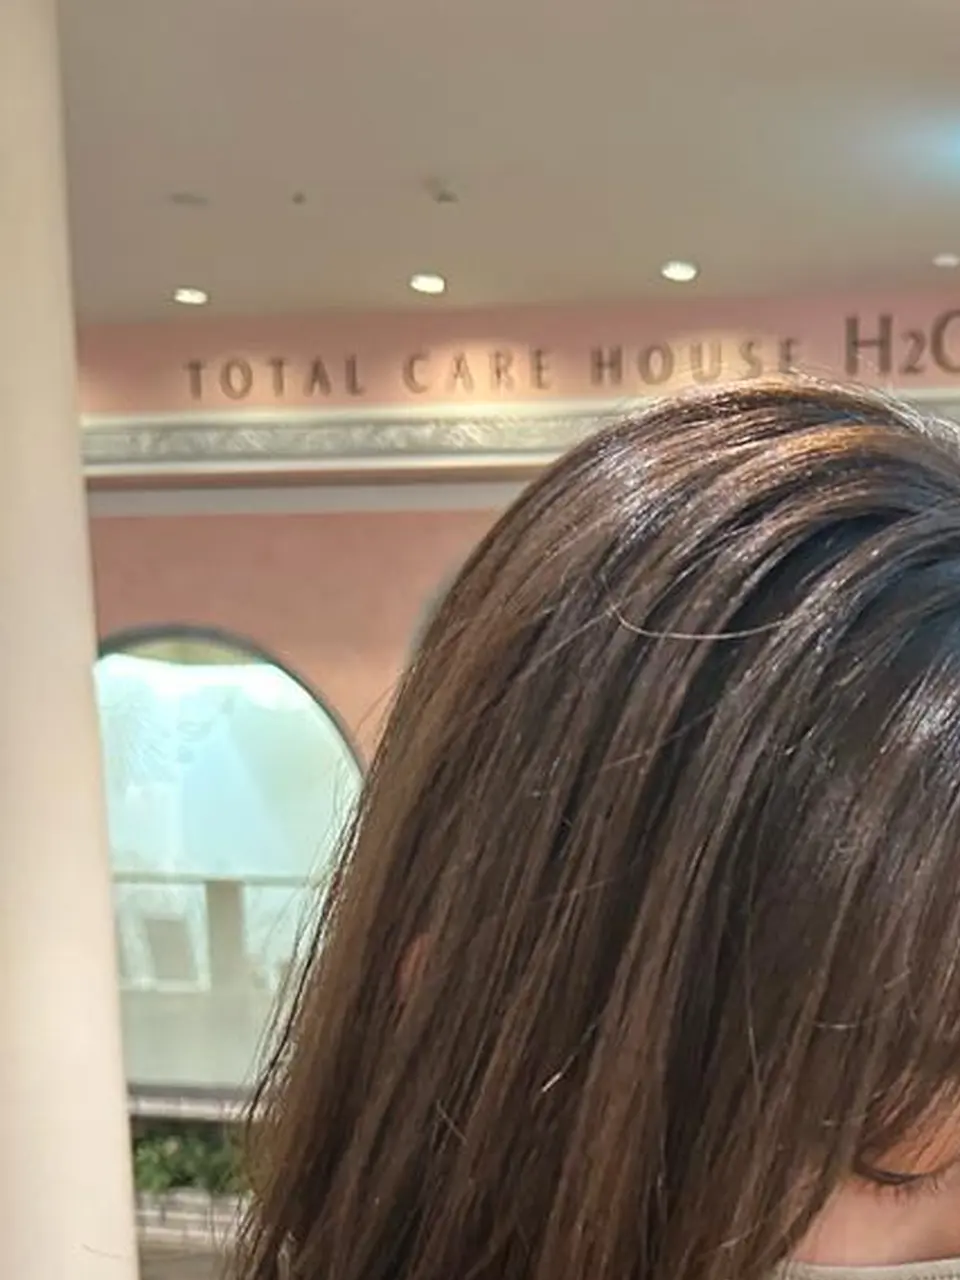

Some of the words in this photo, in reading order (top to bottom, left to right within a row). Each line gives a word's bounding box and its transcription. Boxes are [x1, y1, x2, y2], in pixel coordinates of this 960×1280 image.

[184, 352, 365, 401] TOTAL
[402, 345, 553, 396] CARE
[590, 337, 799, 386] HOUSE
